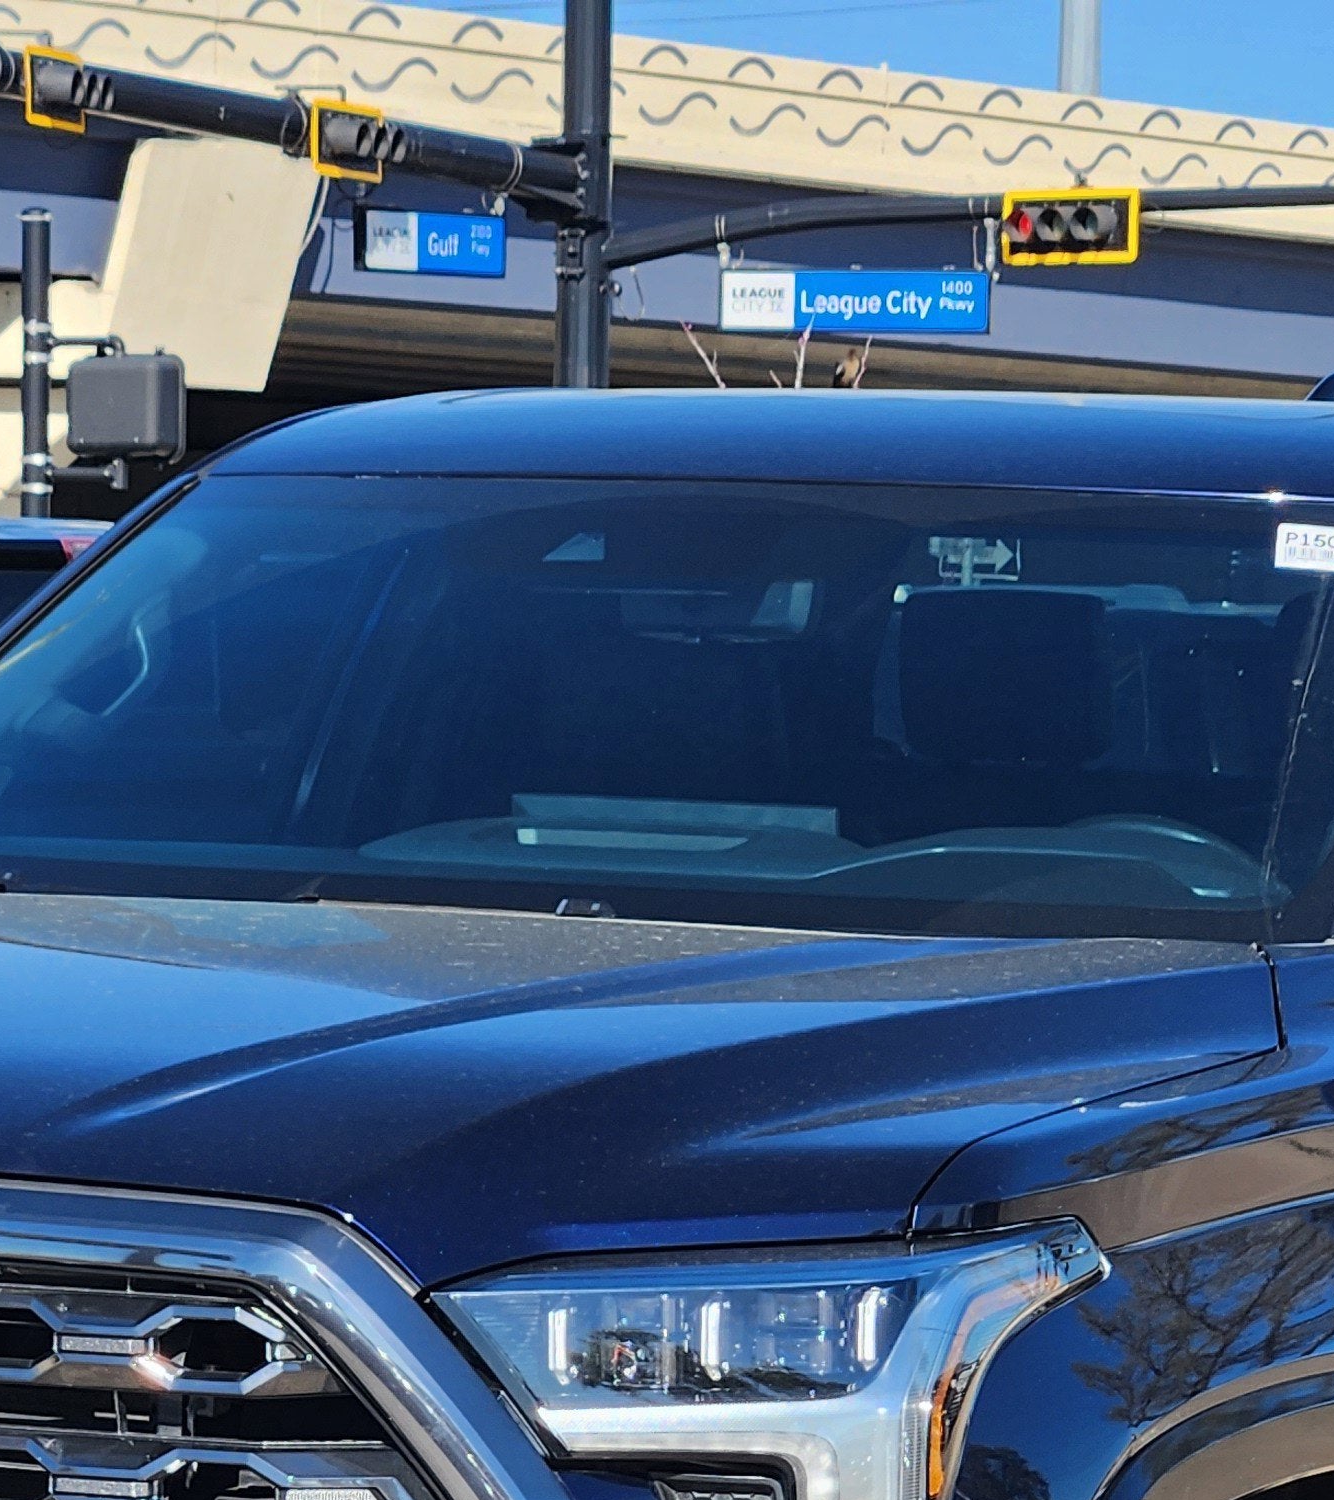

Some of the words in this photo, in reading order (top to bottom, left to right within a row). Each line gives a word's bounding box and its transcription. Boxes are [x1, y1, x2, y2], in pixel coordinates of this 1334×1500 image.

[427, 231, 459, 257] Gulf
[731, 287, 786, 299] LEAGUE
[800, 289, 881, 321] League
[885, 290, 932, 319] City
